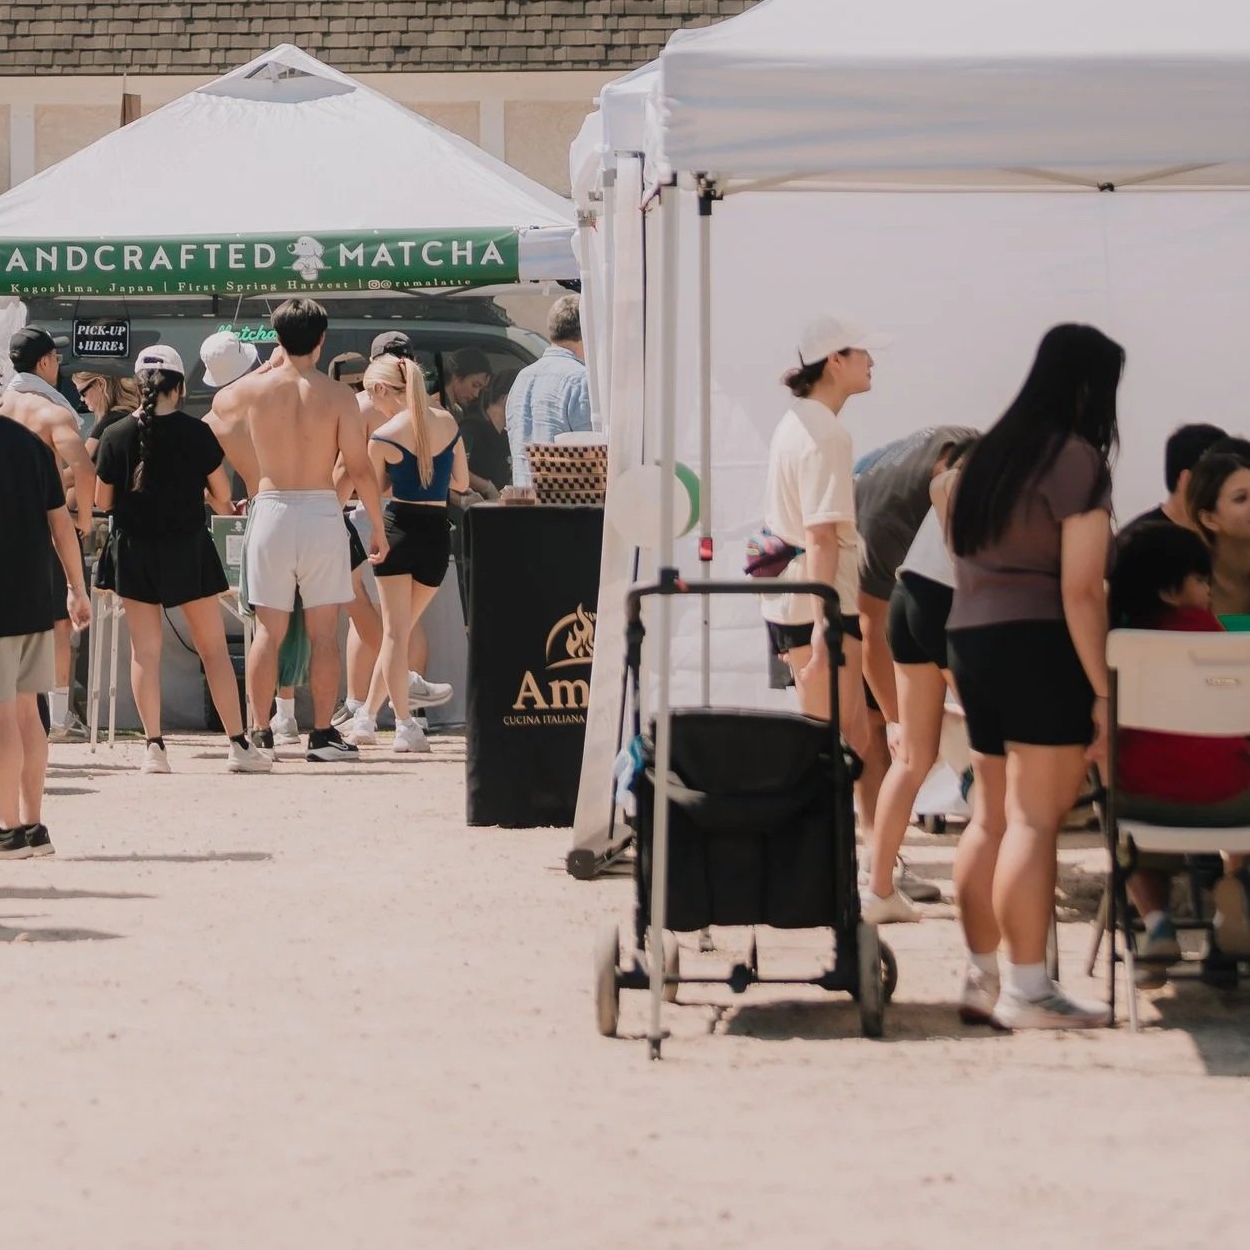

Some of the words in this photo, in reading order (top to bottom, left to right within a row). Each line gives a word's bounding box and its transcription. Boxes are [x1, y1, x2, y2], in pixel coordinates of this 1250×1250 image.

[339, 240, 504, 267] MATCHA
[10, 283, 99, 294] Kagoshima,
[109, 282, 153, 293] Japan
[178, 282, 216, 291] First
[226, 281, 277, 293] Spring
[287, 279, 348, 291] Harvest
[381, 278, 471, 289] @rumalatte
[77, 325, 126, 336] PICK-UP
[84, 341, 119, 351] HERE
[503, 716, 541, 726] CUCINA
[543, 714, 585, 725] ITALIANA
